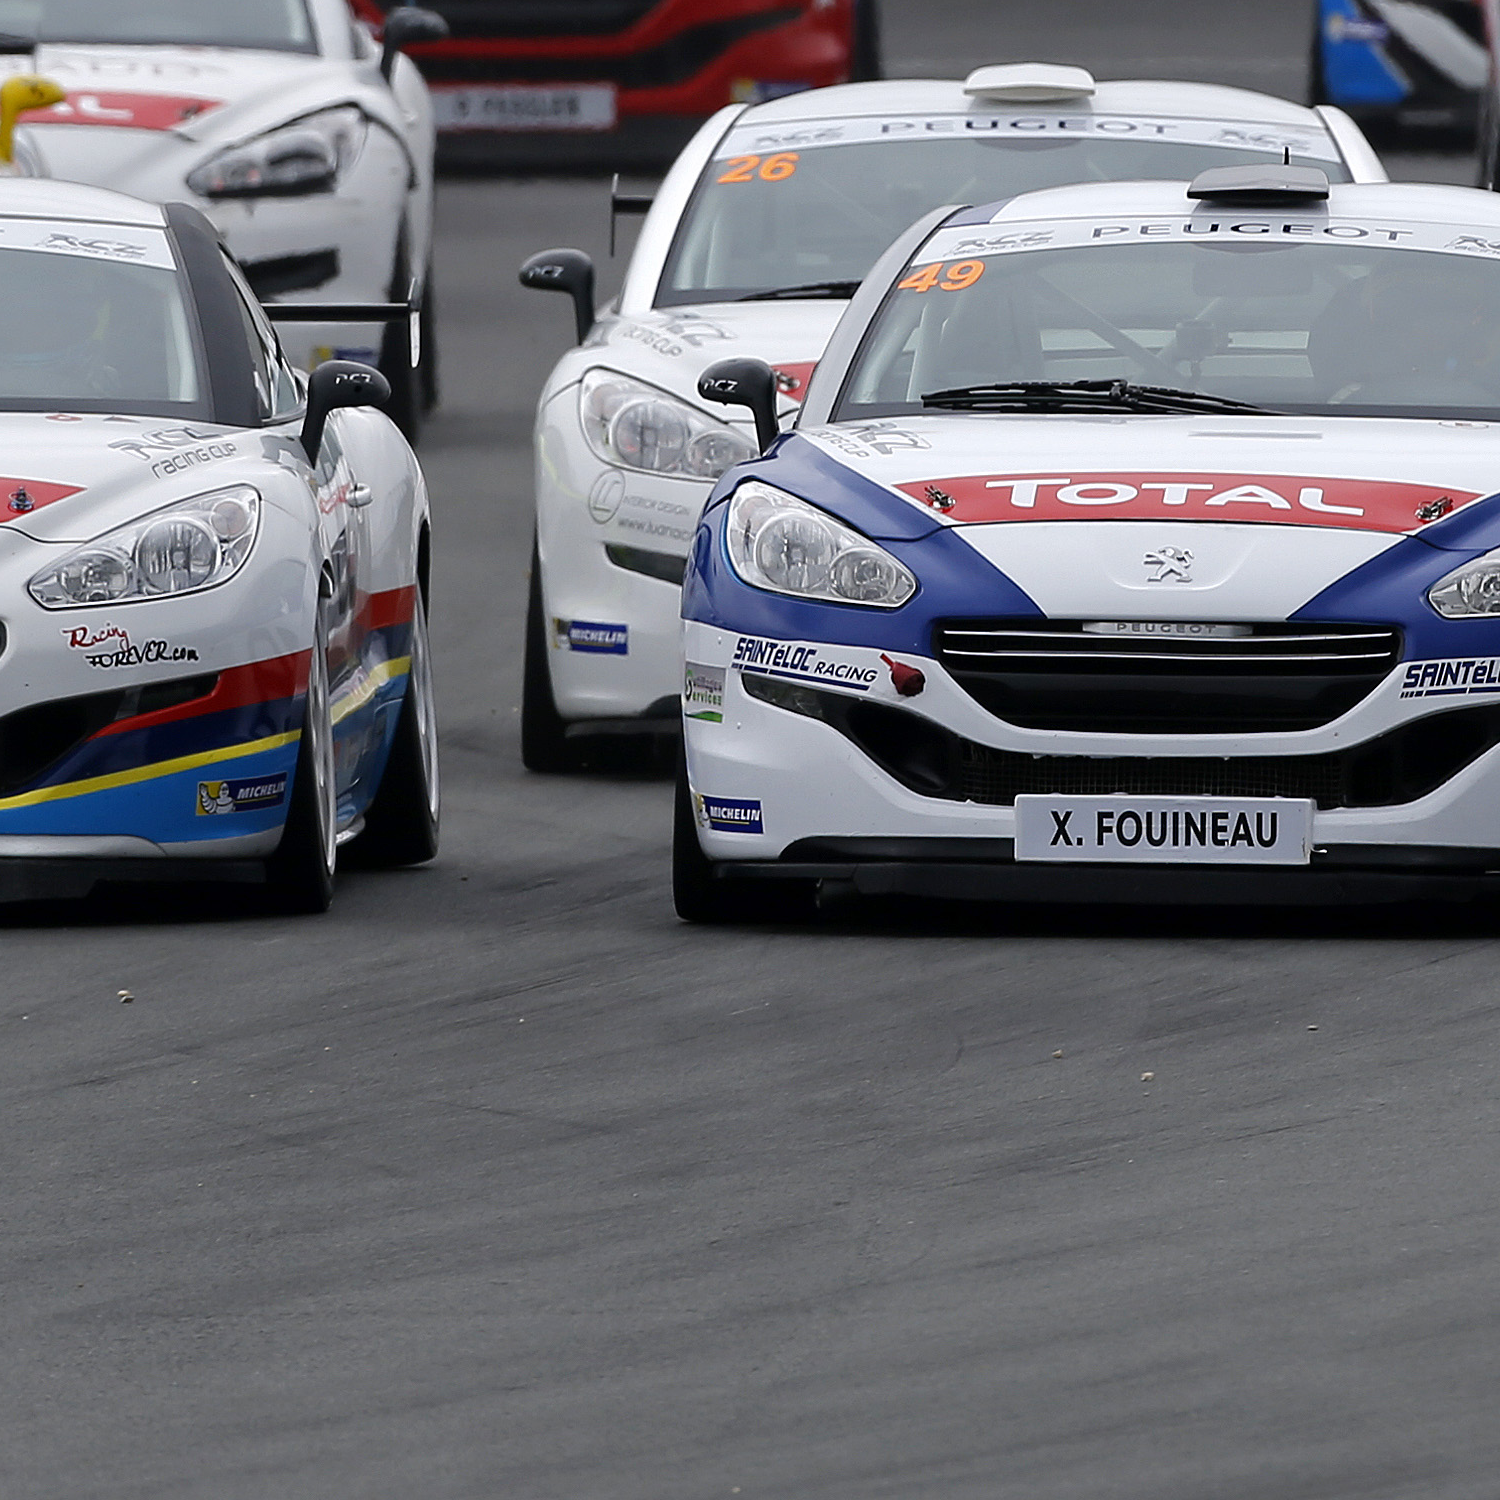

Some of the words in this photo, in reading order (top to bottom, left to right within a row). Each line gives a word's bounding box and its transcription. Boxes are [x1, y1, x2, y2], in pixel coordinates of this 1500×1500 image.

[881, 114, 1186, 136] PEUGEOT
[717, 153, 799, 184] 26
[1091, 222, 1414, 243] PEUGEOT
[898, 261, 986, 294] 49
[986, 478, 1365, 517] TOTAL
[62, 622, 131, 652] Racing
[570, 627, 627, 645] MICHELIN
[1116, 622, 1217, 634] PEUGEOT
[813, 661, 878, 683] RACING
[236, 781, 286, 800] MICHELIN
[709, 805, 761, 822] MICHELIN
[1049, 810, 1084, 847] X.
[1096, 810, 1279, 848] FOUINEAU
